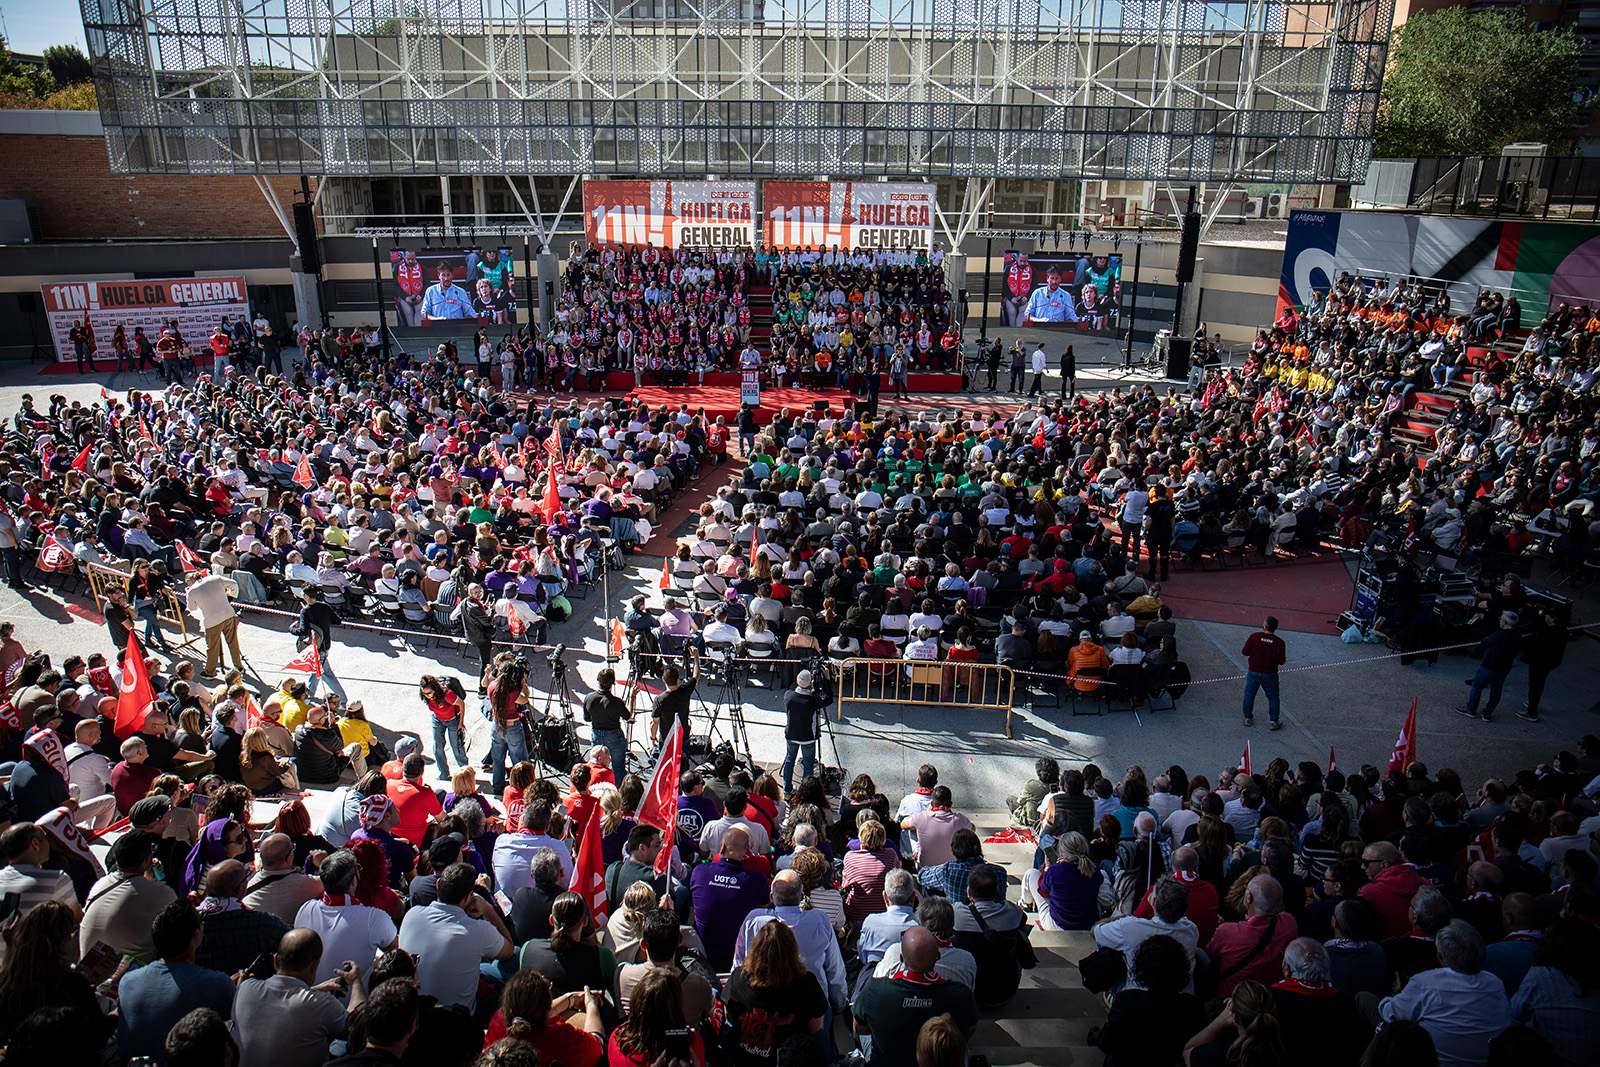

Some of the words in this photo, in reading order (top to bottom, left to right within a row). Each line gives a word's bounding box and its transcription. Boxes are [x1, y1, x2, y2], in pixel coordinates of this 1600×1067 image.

[681, 202, 752, 224] HUELGA
[859, 204, 930, 226] HUELGA
[681, 226, 751, 246] GENERAL
[859, 228, 929, 248] GENERAL
[50, 282, 100, 310] 11N!
[101, 285, 166, 306] HUELGA
[170, 281, 244, 304] GENERAL
[714, 874, 731, 884] UGT
[902, 995, 933, 1008] prince
